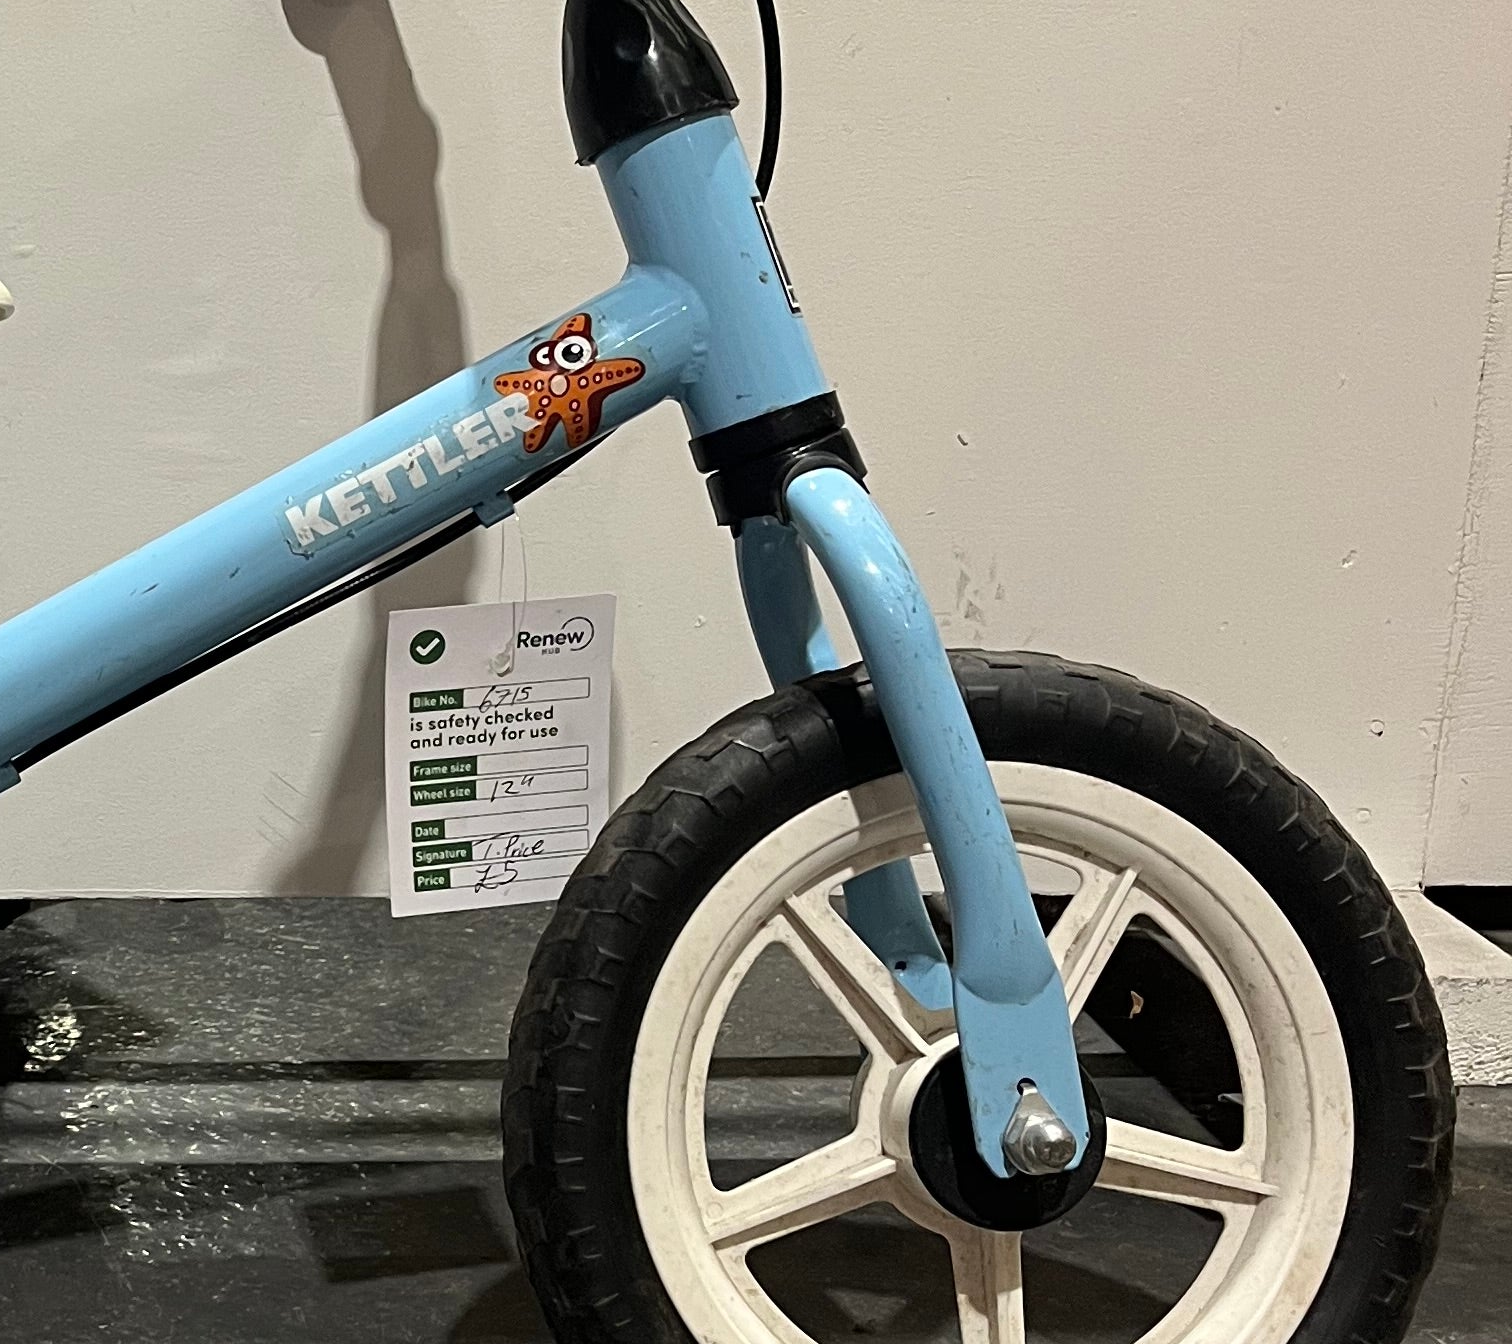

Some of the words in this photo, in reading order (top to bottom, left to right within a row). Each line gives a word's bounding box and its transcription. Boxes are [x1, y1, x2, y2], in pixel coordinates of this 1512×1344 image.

[285, 391, 541, 546] KETTLER
[516, 630, 585, 649] Renew
[413, 697, 437, 708] Bike
[439, 694, 458, 706] No.
[410, 717, 423, 732] is
[428, 713, 481, 731] safety
[484, 705, 554, 726] checked
[410, 732, 443, 750] and
[448, 727, 497, 747] ready
[501, 725, 526, 741] for
[529, 726, 559, 739] use
[413, 763, 449, 776] Frame
[450, 761, 472, 772] size
[413, 788, 448, 801] Wheel
[449, 785, 471, 796] size
[414, 825, 439, 837] Date
[416, 848, 467, 862] Signature
[417, 874, 445, 886] Price
